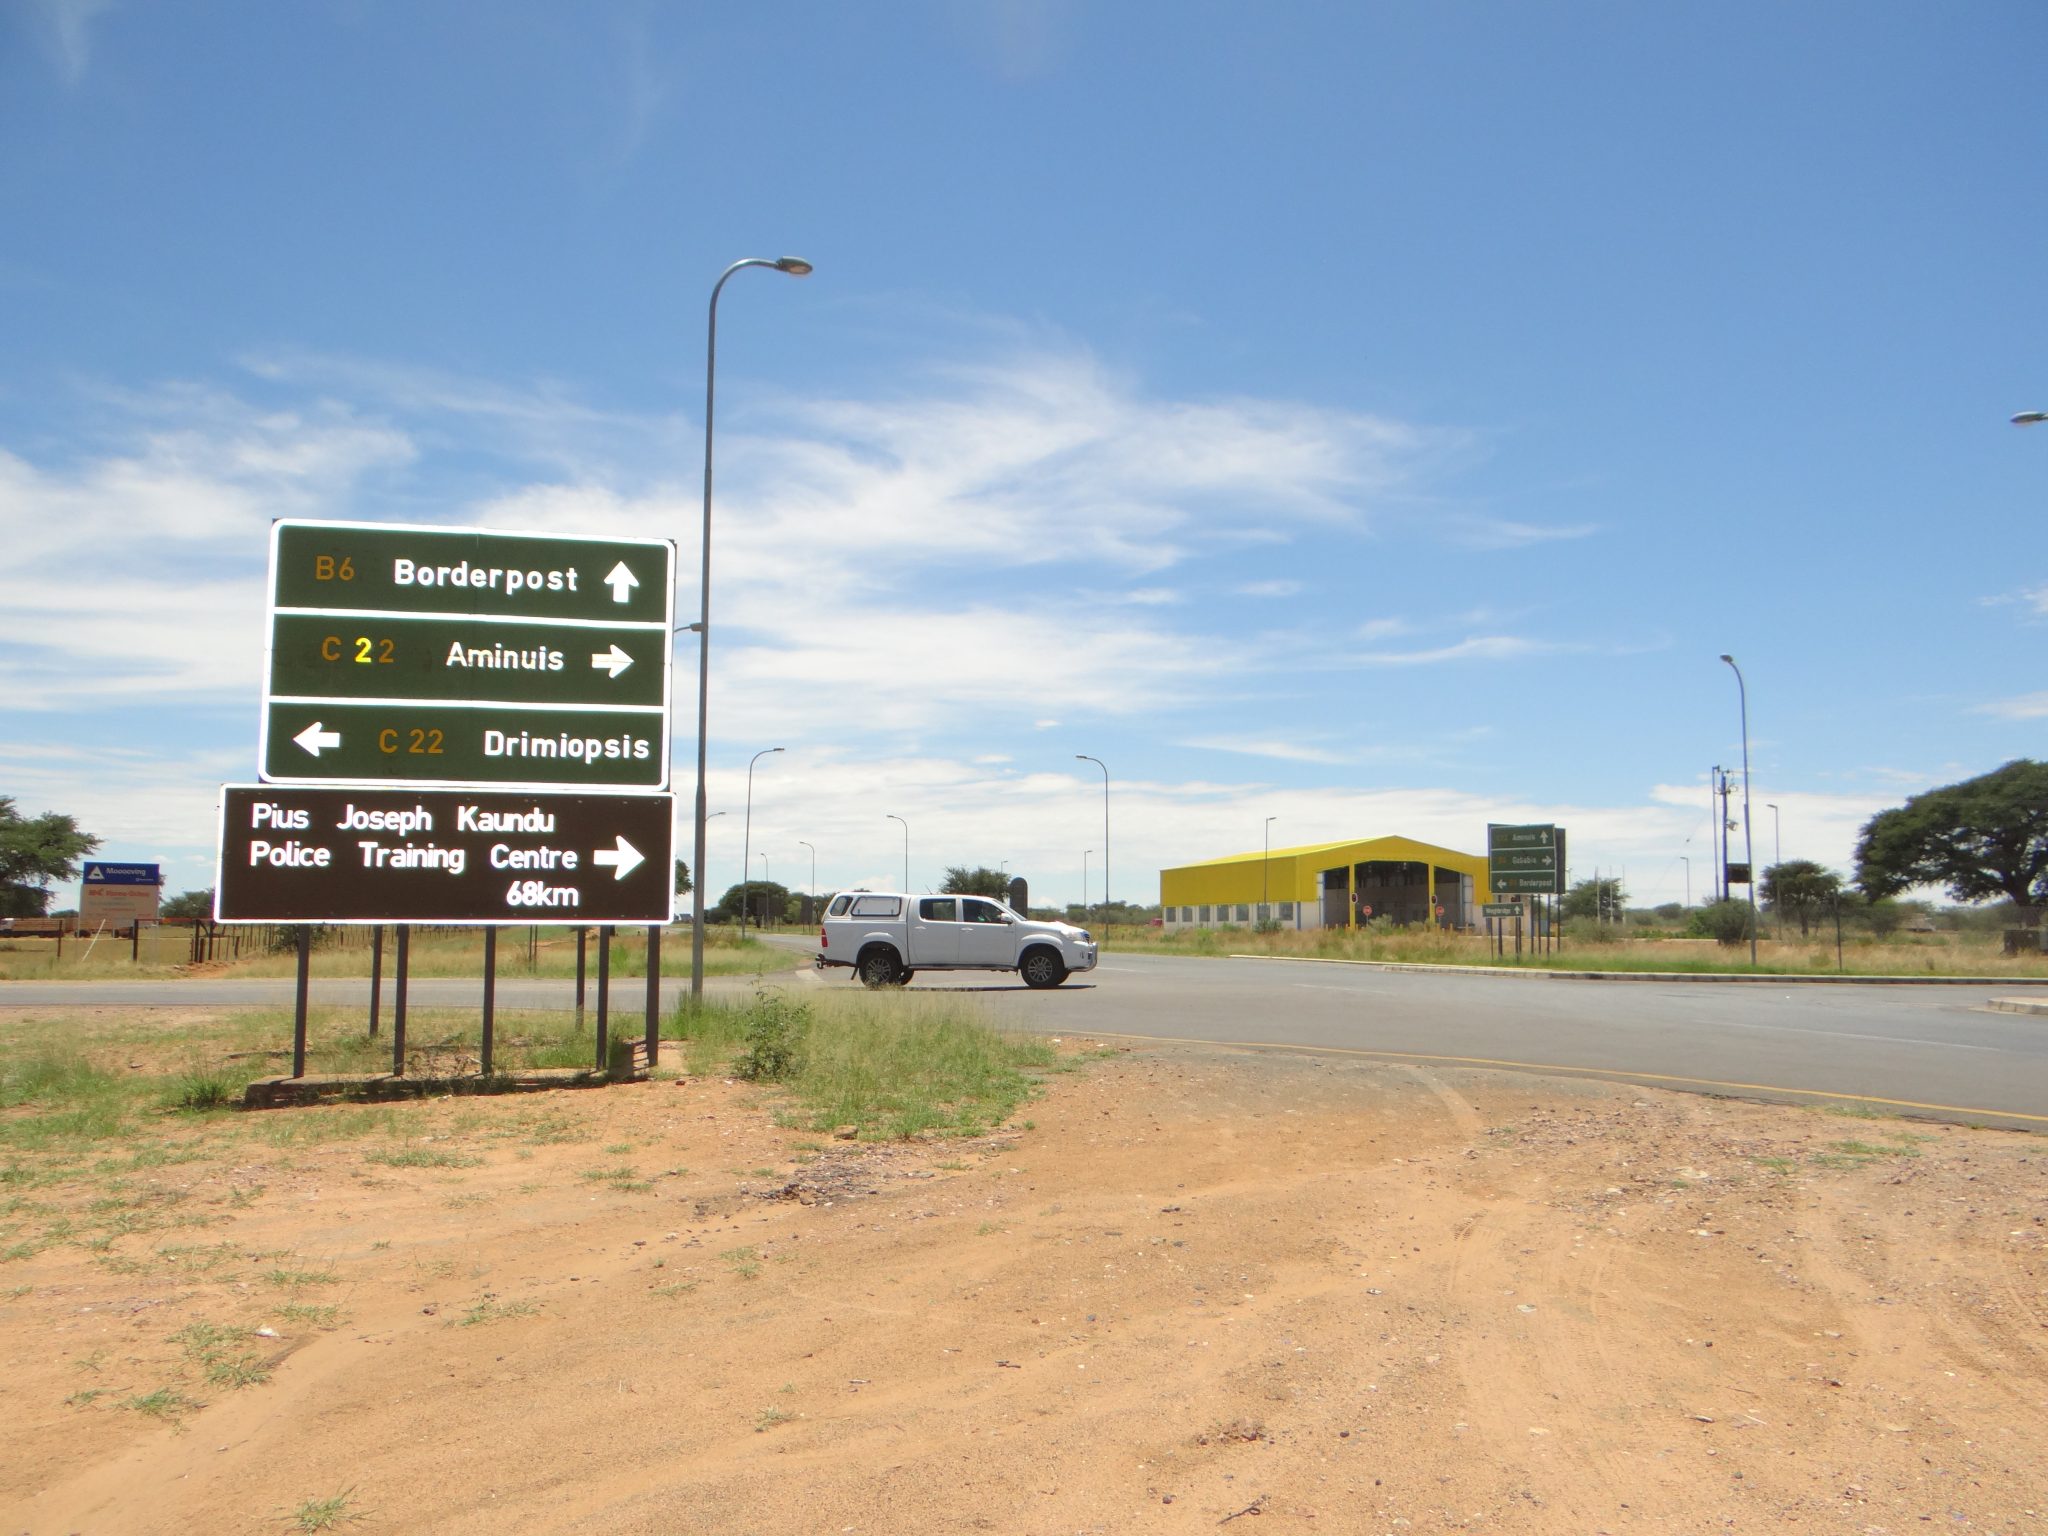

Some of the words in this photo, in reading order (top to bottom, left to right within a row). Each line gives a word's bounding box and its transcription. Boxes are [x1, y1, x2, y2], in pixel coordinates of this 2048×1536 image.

[314, 554, 356, 581] B6
[395, 559, 577, 594] Borderpost
[321, 636, 342, 661] C
[446, 642, 564, 671] Aminuis
[378, 728, 399, 754] C
[408, 729, 445, 755] 22
[484, 731, 649, 764] Drimiopsis
[251, 803, 309, 829] Pius
[336, 804, 432, 836] Joseph
[457, 806, 554, 833] Kaundu
[250, 841, 330, 867] Police
[359, 842, 465, 874] Training
[490, 844, 578, 870] Centre
[506, 880, 579, 907] 68km
